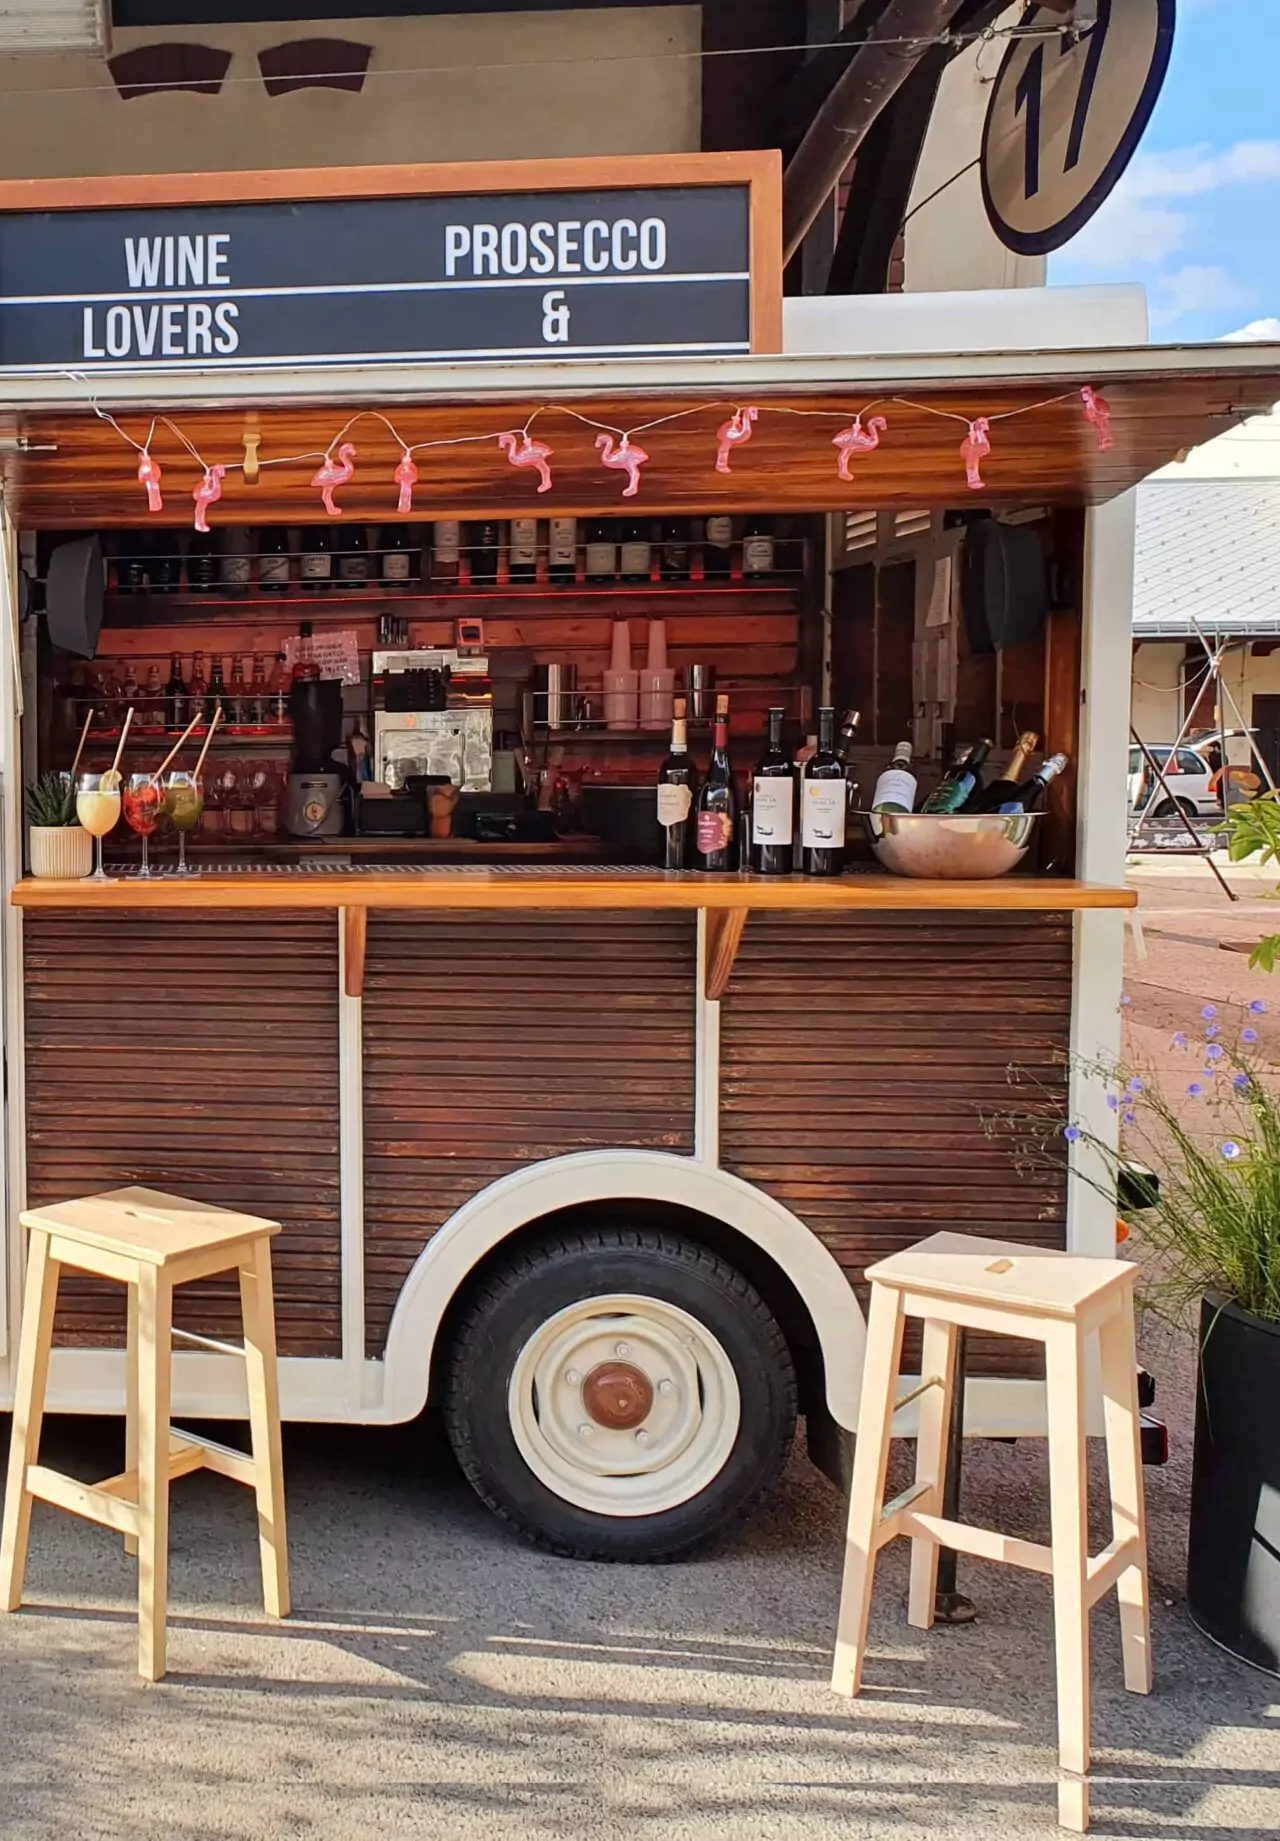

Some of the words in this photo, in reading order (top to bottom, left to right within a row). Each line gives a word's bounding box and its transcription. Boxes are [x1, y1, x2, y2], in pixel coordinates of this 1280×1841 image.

[124, 234, 230, 287] WINE
[445, 217, 667, 276] PROSECCO
[83, 302, 239, 357] LOVERS
[541, 290, 570, 342] &
